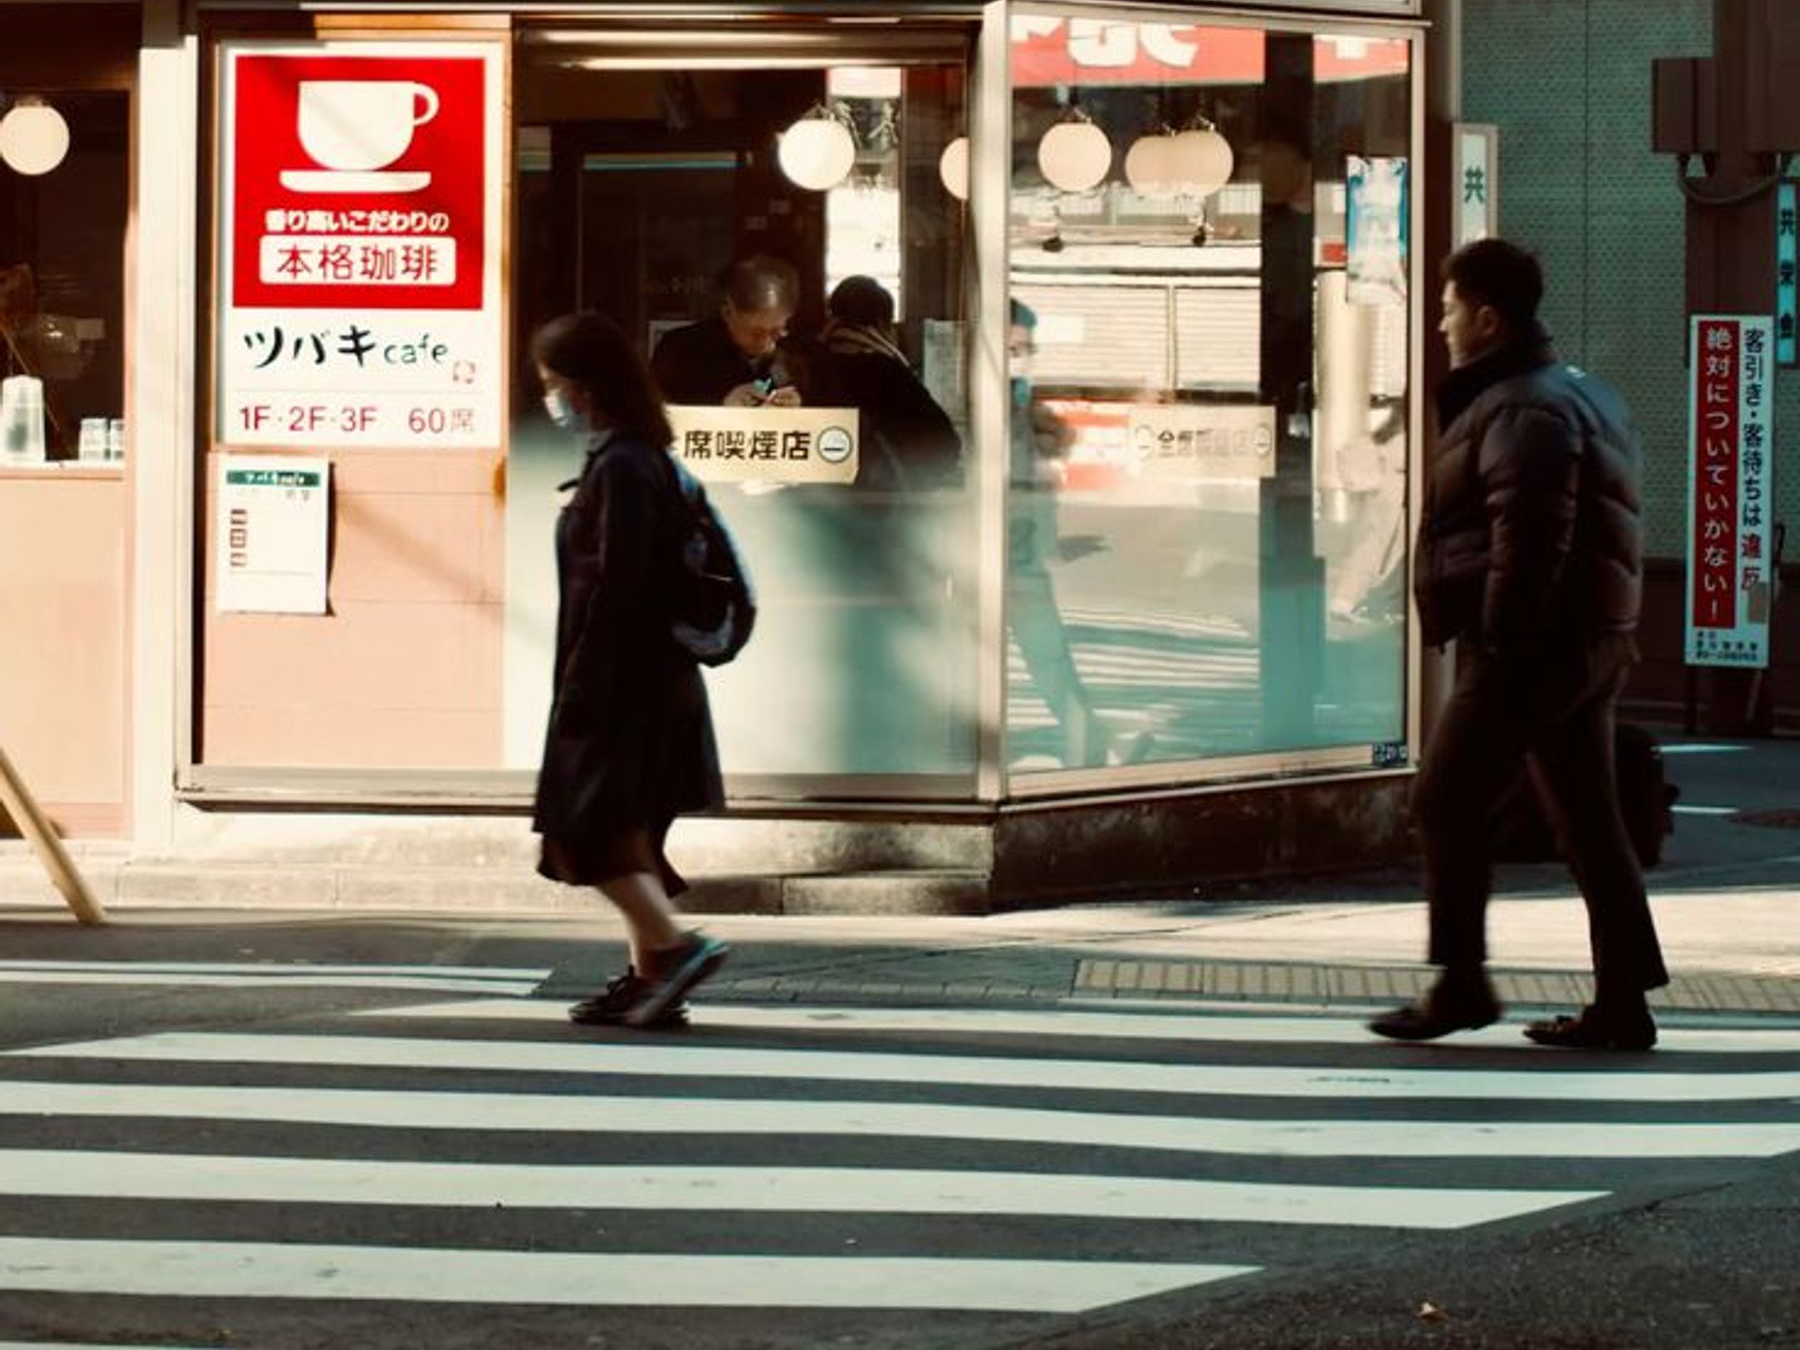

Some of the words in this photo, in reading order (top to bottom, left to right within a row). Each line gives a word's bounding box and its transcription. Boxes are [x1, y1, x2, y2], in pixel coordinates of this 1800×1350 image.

[265, 209, 450, 233] 香り高いこだわりの
[276, 242, 439, 281] 本格珈琲
[408, 408, 476, 434] 60席
